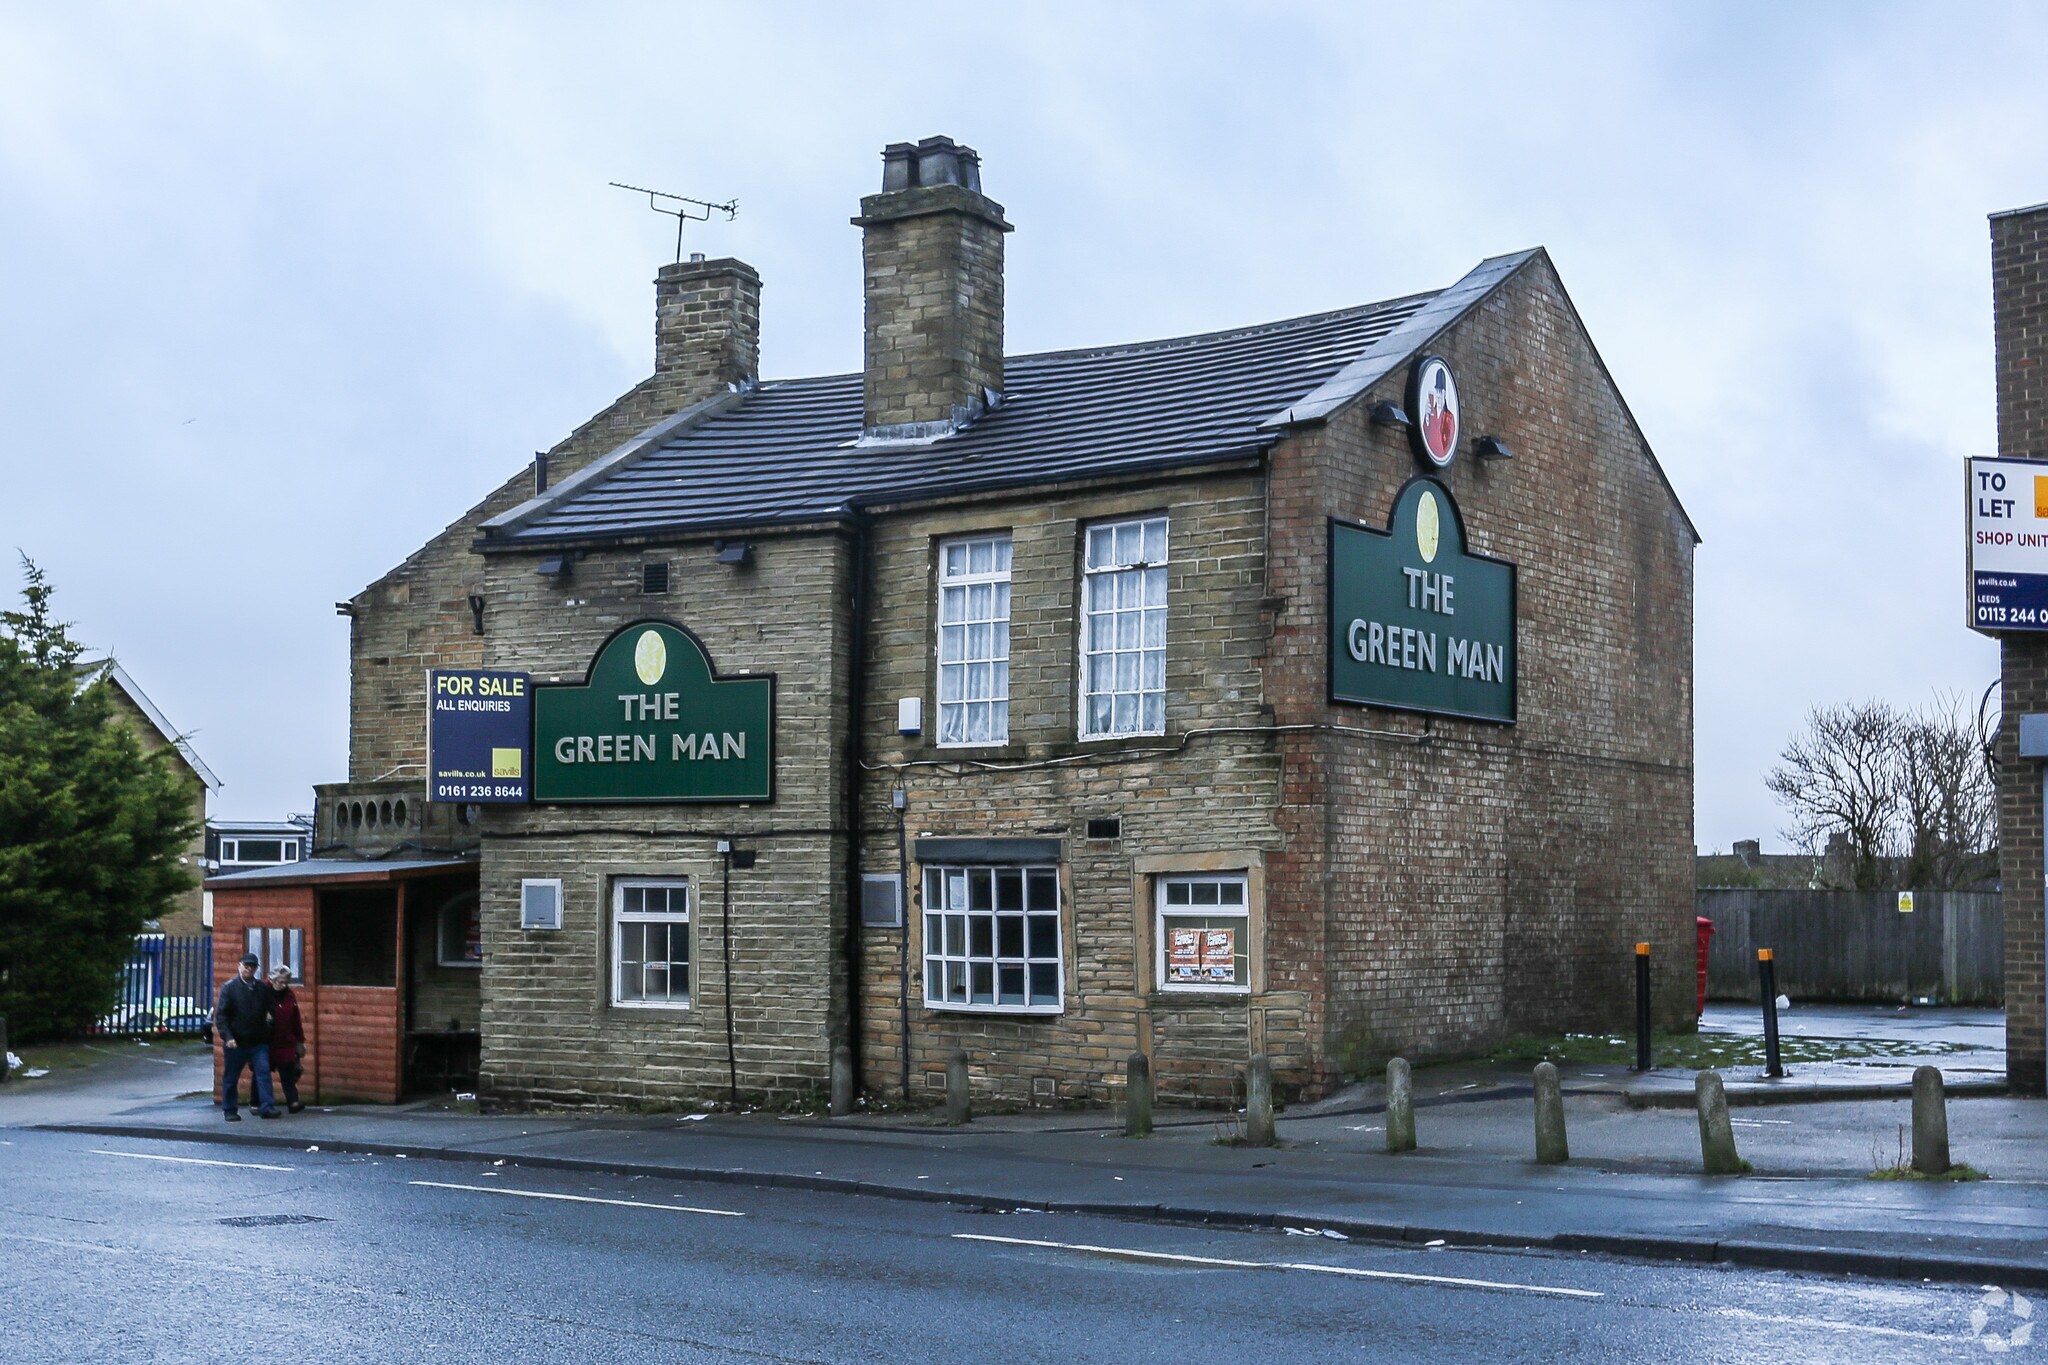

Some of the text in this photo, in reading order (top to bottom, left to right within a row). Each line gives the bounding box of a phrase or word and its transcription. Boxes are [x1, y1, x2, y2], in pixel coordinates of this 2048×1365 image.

[1978, 471, 2006, 492] TO
[1979, 498, 2015, 518] LET
[1976, 531, 2013, 546] SHOP
[1978, 577, 2017, 587] savills.co.uk
[1403, 567, 1454, 615] THE
[1978, 595, 2000, 604] LEEDS
[1978, 606, 2006, 622] 0113
[2010, 608, 2036, 623] 244
[1349, 618, 1503, 683] GREEN MAN
[437, 676, 524, 696] FOR SALE
[436, 699, 511, 712] ALL ENQUIRIES
[618, 693, 680, 721] THE
[554, 732, 746, 763] GREEN MAN
[438, 770, 486, 778] savills.co.uk
[494, 767, 520, 776] savills
[439, 785, 523, 798] 0161 236 8644
